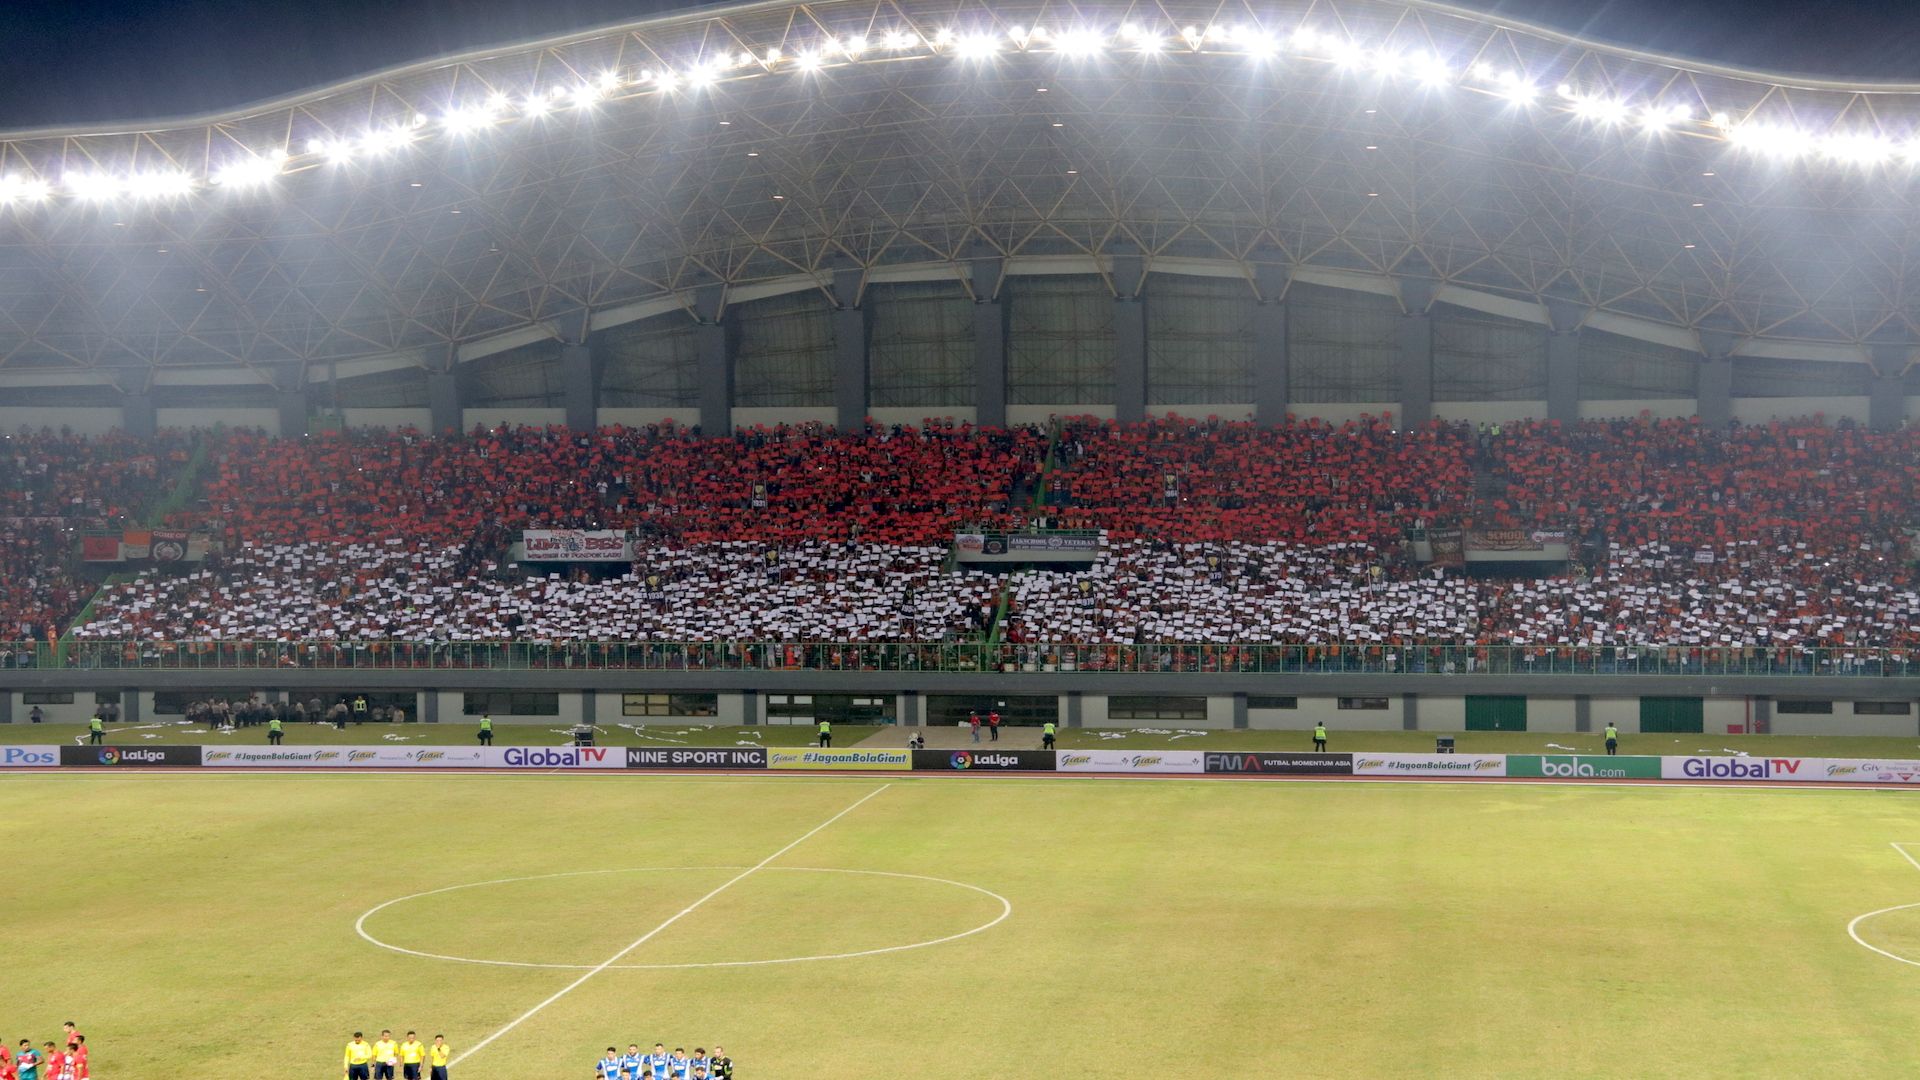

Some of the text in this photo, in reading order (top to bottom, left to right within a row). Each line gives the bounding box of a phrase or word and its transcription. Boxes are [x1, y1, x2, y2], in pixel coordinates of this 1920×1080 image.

[5, 748, 54, 763] Pos
[122, 750, 165, 761] LaLiga
[206, 750, 340, 761] Giant #JagoanBolaGiant Giant
[347, 750, 377, 761] Giant
[415, 750, 444, 761] Giant
[629, 751, 765, 764] NINE SPORT INC.
[771, 752, 907, 764] Giant #JagoanBolaGiant
[974, 753, 1018, 766] LaLiga
[1061, 754, 1091, 767] Giant
[1132, 755, 1162, 767] Giant
[1206, 755, 1261, 770] FMA
[1356, 758, 1502, 770] Giant #JagoanBolaGiant Giant
[1541, 756, 1626, 777] bola.com
[1826, 764, 1857, 776] Giant
